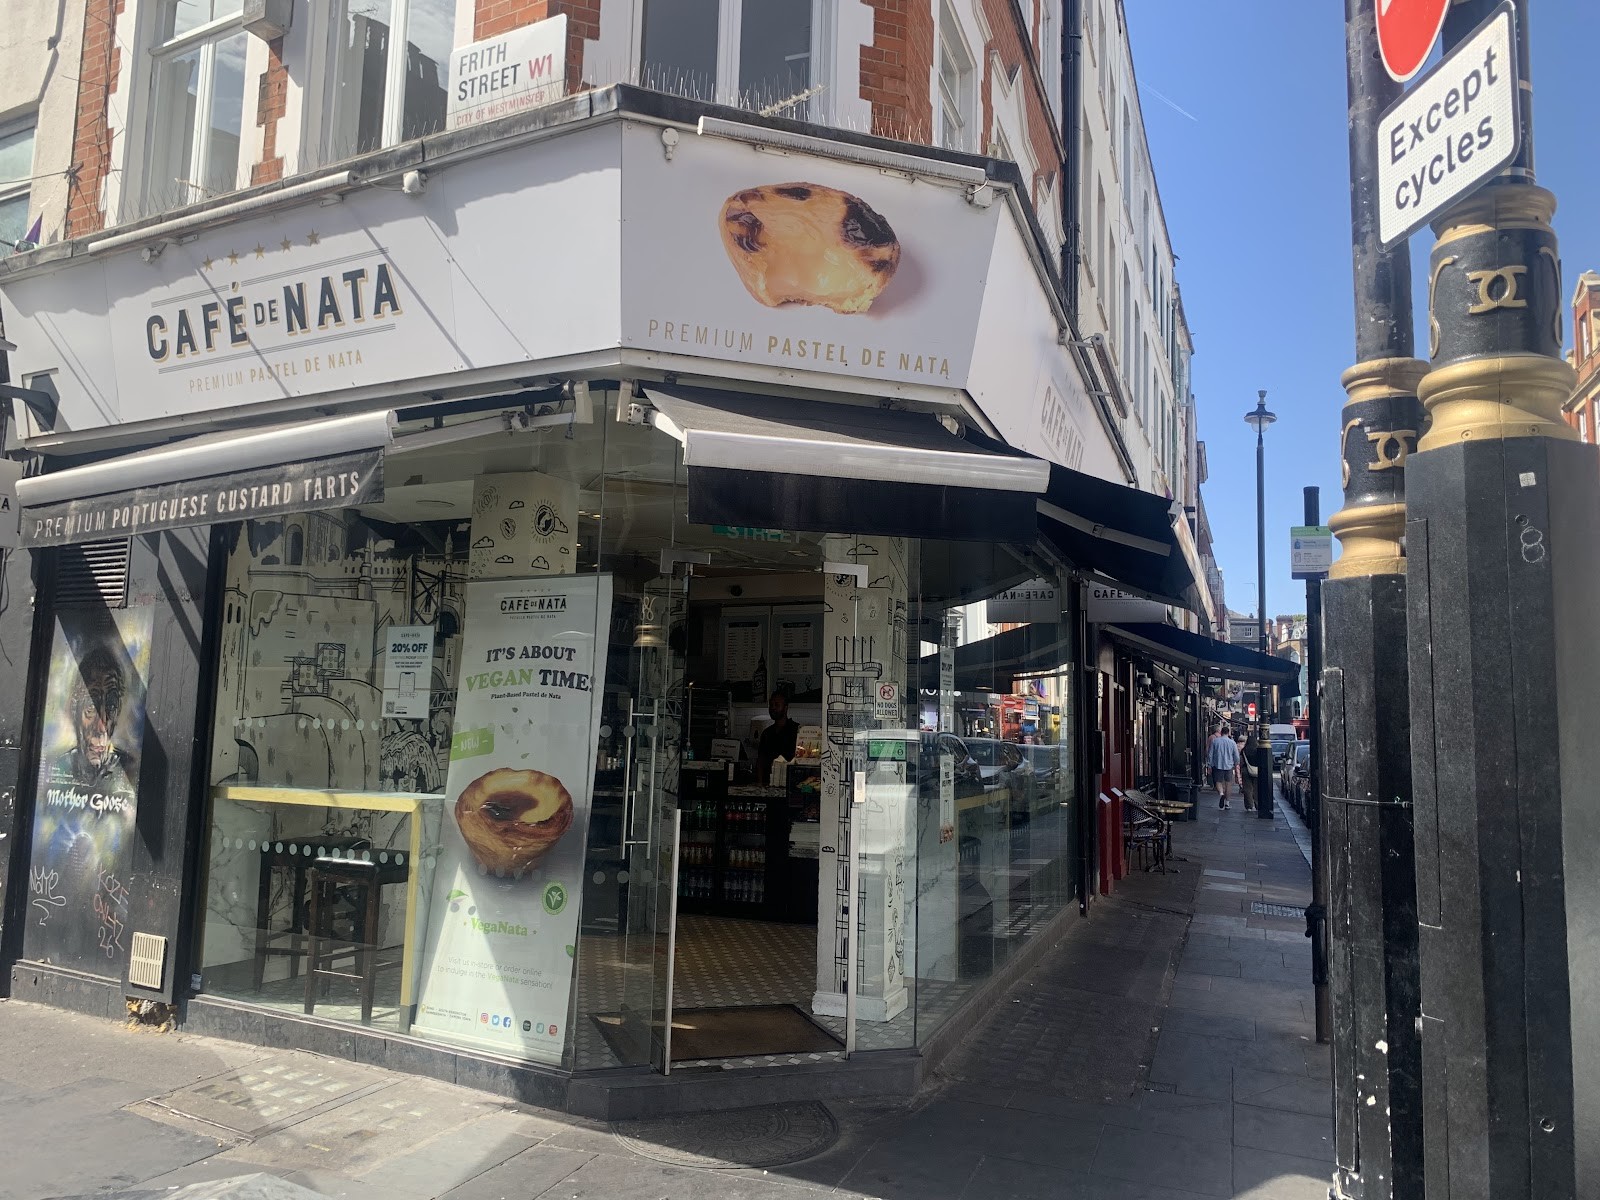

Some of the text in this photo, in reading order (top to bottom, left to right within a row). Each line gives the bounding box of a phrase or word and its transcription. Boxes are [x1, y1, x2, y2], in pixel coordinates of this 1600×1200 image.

[460, 42, 507, 76] FRITH
[458, 53, 553, 101] STREET W1
[456, 91, 545, 126] CITY OF WESTMINSTER
[1390, 45, 1498, 165] Except
[1395, 115, 1494, 210] cycles
[146, 263, 403, 363] CAFÉ DE NATA
[648, 318, 950, 376] PREMIUM PASTEL DE NATA
[189, 349, 363, 393] PREMIUM PASTEL DE NATA
[33, 471, 360, 539] PREMIUM PORTUGUESE CUSTARD TARTS
[538, 598, 567, 610] NATA
[391, 643, 428, 653] 20% OFF
[486, 645, 576, 663] IT'S ABOUT
[465, 668, 534, 692] VEGAN
[490, 691, 521, 700] Plant-Based
[460, 735, 479, 751] NEW
[46, 786, 130, 819] Mother Goose
[470, 917, 528, 936] VegaNata
[475, 970, 486, 979] the
[503, 964, 521, 974] order
[522, 967, 542, 977] online
